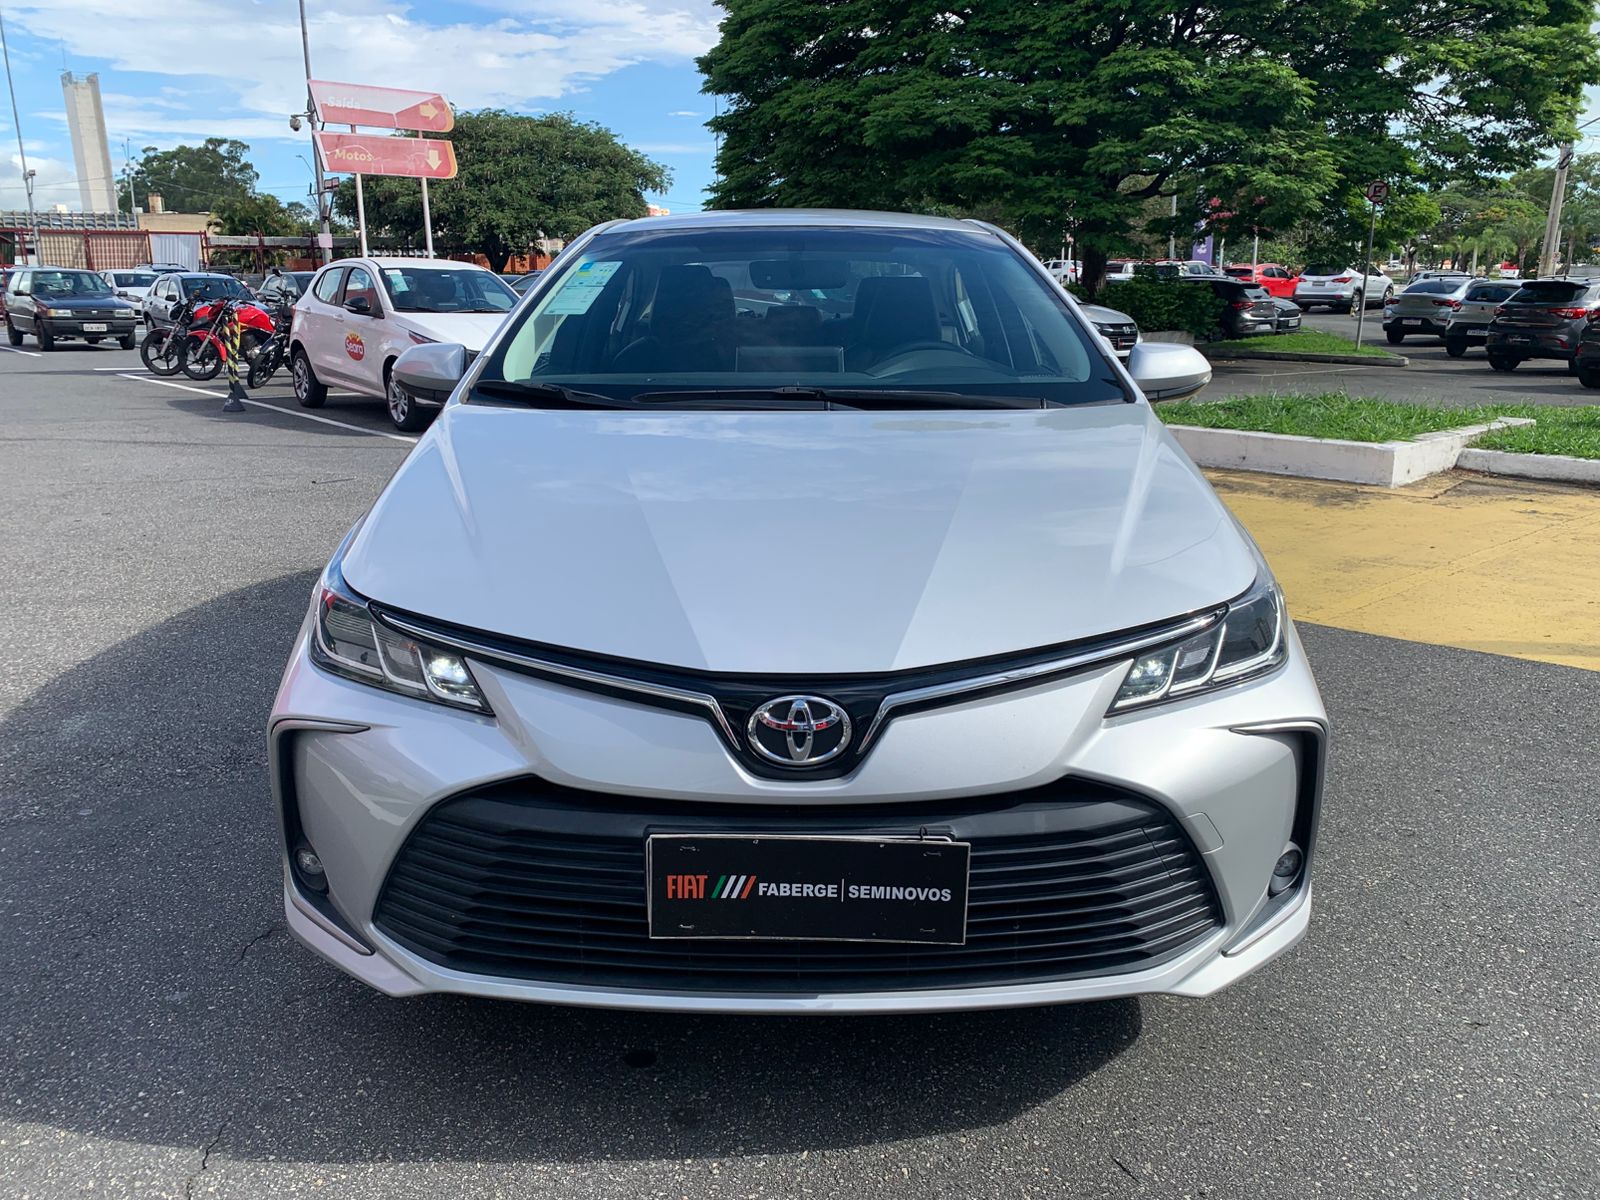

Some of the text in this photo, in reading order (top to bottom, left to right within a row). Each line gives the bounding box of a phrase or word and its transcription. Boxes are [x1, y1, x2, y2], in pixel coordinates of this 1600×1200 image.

[334, 149, 373, 162] Motos
[666, 874, 951, 901] FIAT FABERGE SEMINOVOS
